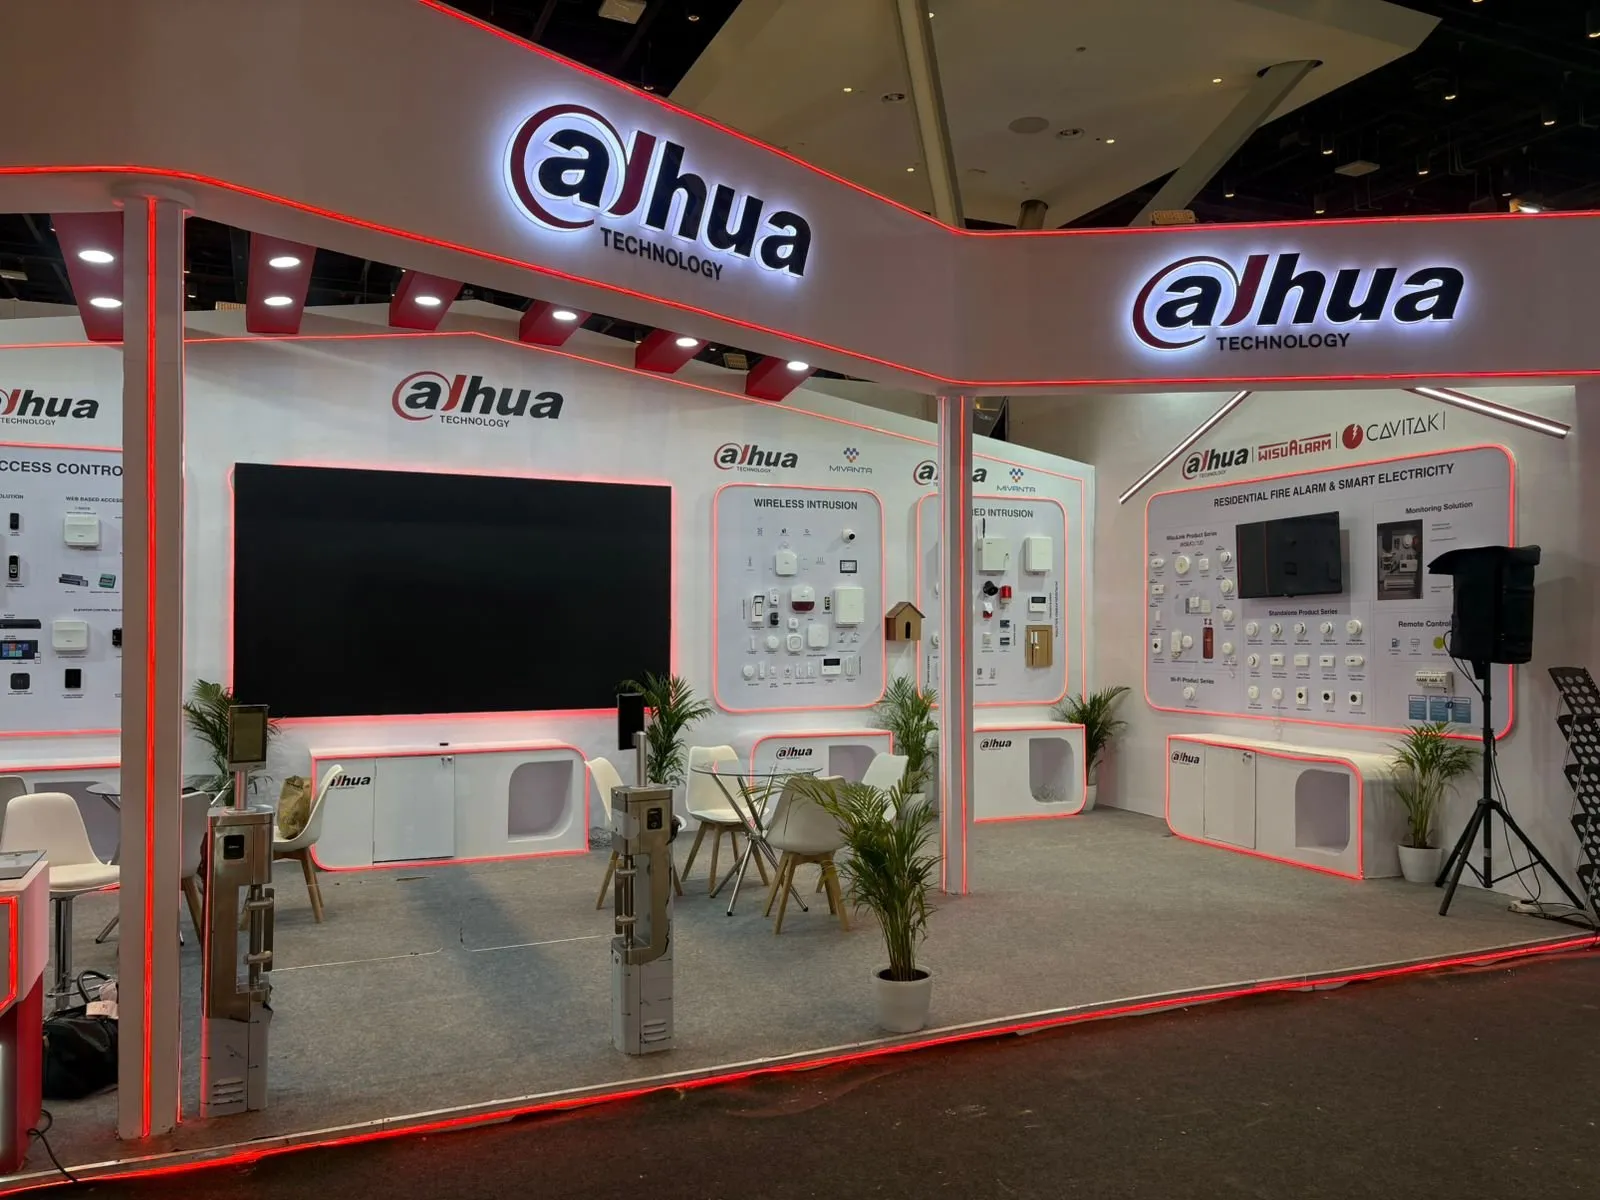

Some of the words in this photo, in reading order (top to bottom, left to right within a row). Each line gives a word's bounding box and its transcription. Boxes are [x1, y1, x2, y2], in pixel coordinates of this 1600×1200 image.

[600, 227, 723, 281] TECHNOLOGY
[1216, 333, 1350, 351] TECHNOLOGY
[0, 417, 56, 426] TECHNOLOGY
[440, 415, 510, 427] TECHNOLOGY
[1367, 413, 1438, 442] CAVITAK
[829, 465, 872, 474] MIVANTA
[1214, 491, 1268, 507] RESIDENTIAL
[1270, 487, 1290, 502] FIRE
[1292, 482, 1326, 498] ALARM
[1329, 481, 1336, 492] &
[1338, 475, 1375, 490] SMART
[1378, 463, 1454, 484] ELECTRICITY
[754, 498, 804, 509] WIRELESS
[807, 500, 858, 510] INTRUSION
[1405, 505, 1442, 514] Monitoring
[1443, 501, 1473, 510] Solution
[988, 508, 1033, 518] INTRUSION
[1398, 620, 1424, 628] Remote
